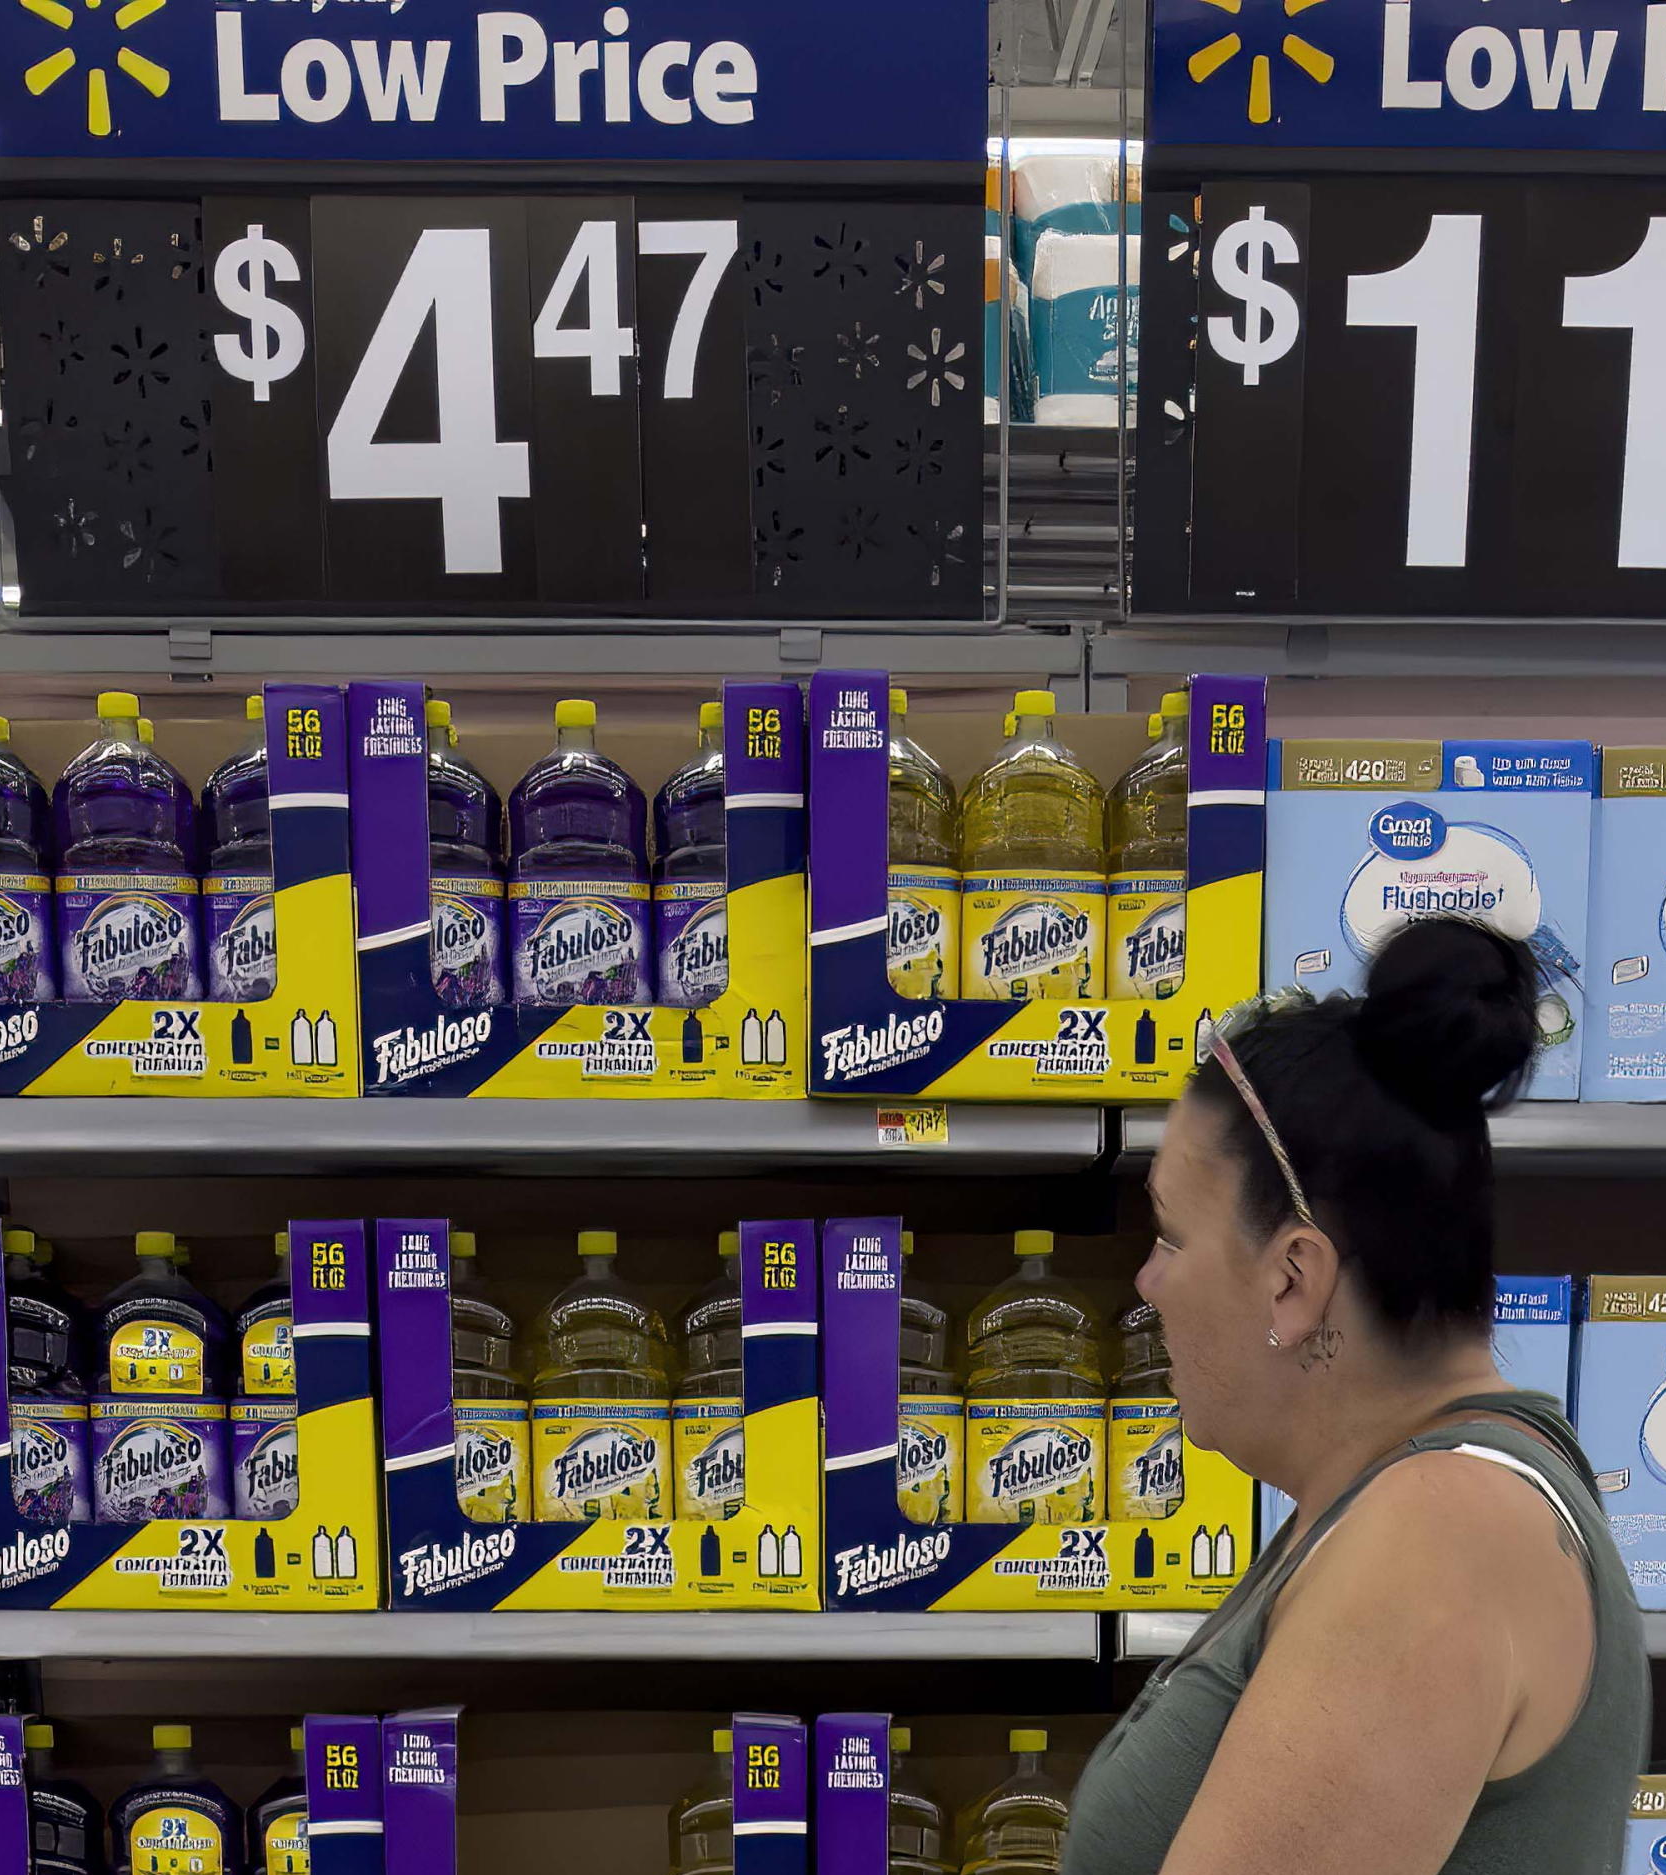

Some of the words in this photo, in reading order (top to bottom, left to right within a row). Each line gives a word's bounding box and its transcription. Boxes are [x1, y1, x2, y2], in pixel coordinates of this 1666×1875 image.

[215, 11, 451, 123] Low
[477, 6, 758, 126] Price
[1382, 4, 1619, 112] Low
[287, 709, 321, 733] 56
[748, 708, 781, 733] 56
[1211, 704, 1246, 730] 56
[78, 909, 183, 976] Fabuloso
[530, 914, 633, 977] Fabuloso
[982, 911, 1088, 977] Fabuloso
[153, 1010, 200, 1039] 2X
[603, 1010, 654, 1041] 2X
[1058, 1010, 1108, 1042] 2X
[373, 1008, 492, 1083] Fabuloso
[821, 1006, 945, 1081] Fabuloso
[312, 1242, 345, 1265] 56
[764, 1242, 796, 1265] 56
[104, 1438, 202, 1495] Fabuloso
[554, 1437, 657, 1499] Fabuloso
[990, 1437, 1092, 1498] Fabuloso
[179, 1527, 226, 1556] 2X
[623, 1526, 671, 1556] 2X
[1060, 1529, 1109, 1559] 2X
[399, 1528, 515, 1597] Fabuloso
[834, 1530, 951, 1597] Fabuloso
[326, 1744, 358, 1767] 56
[748, 1744, 780, 1768] 56
